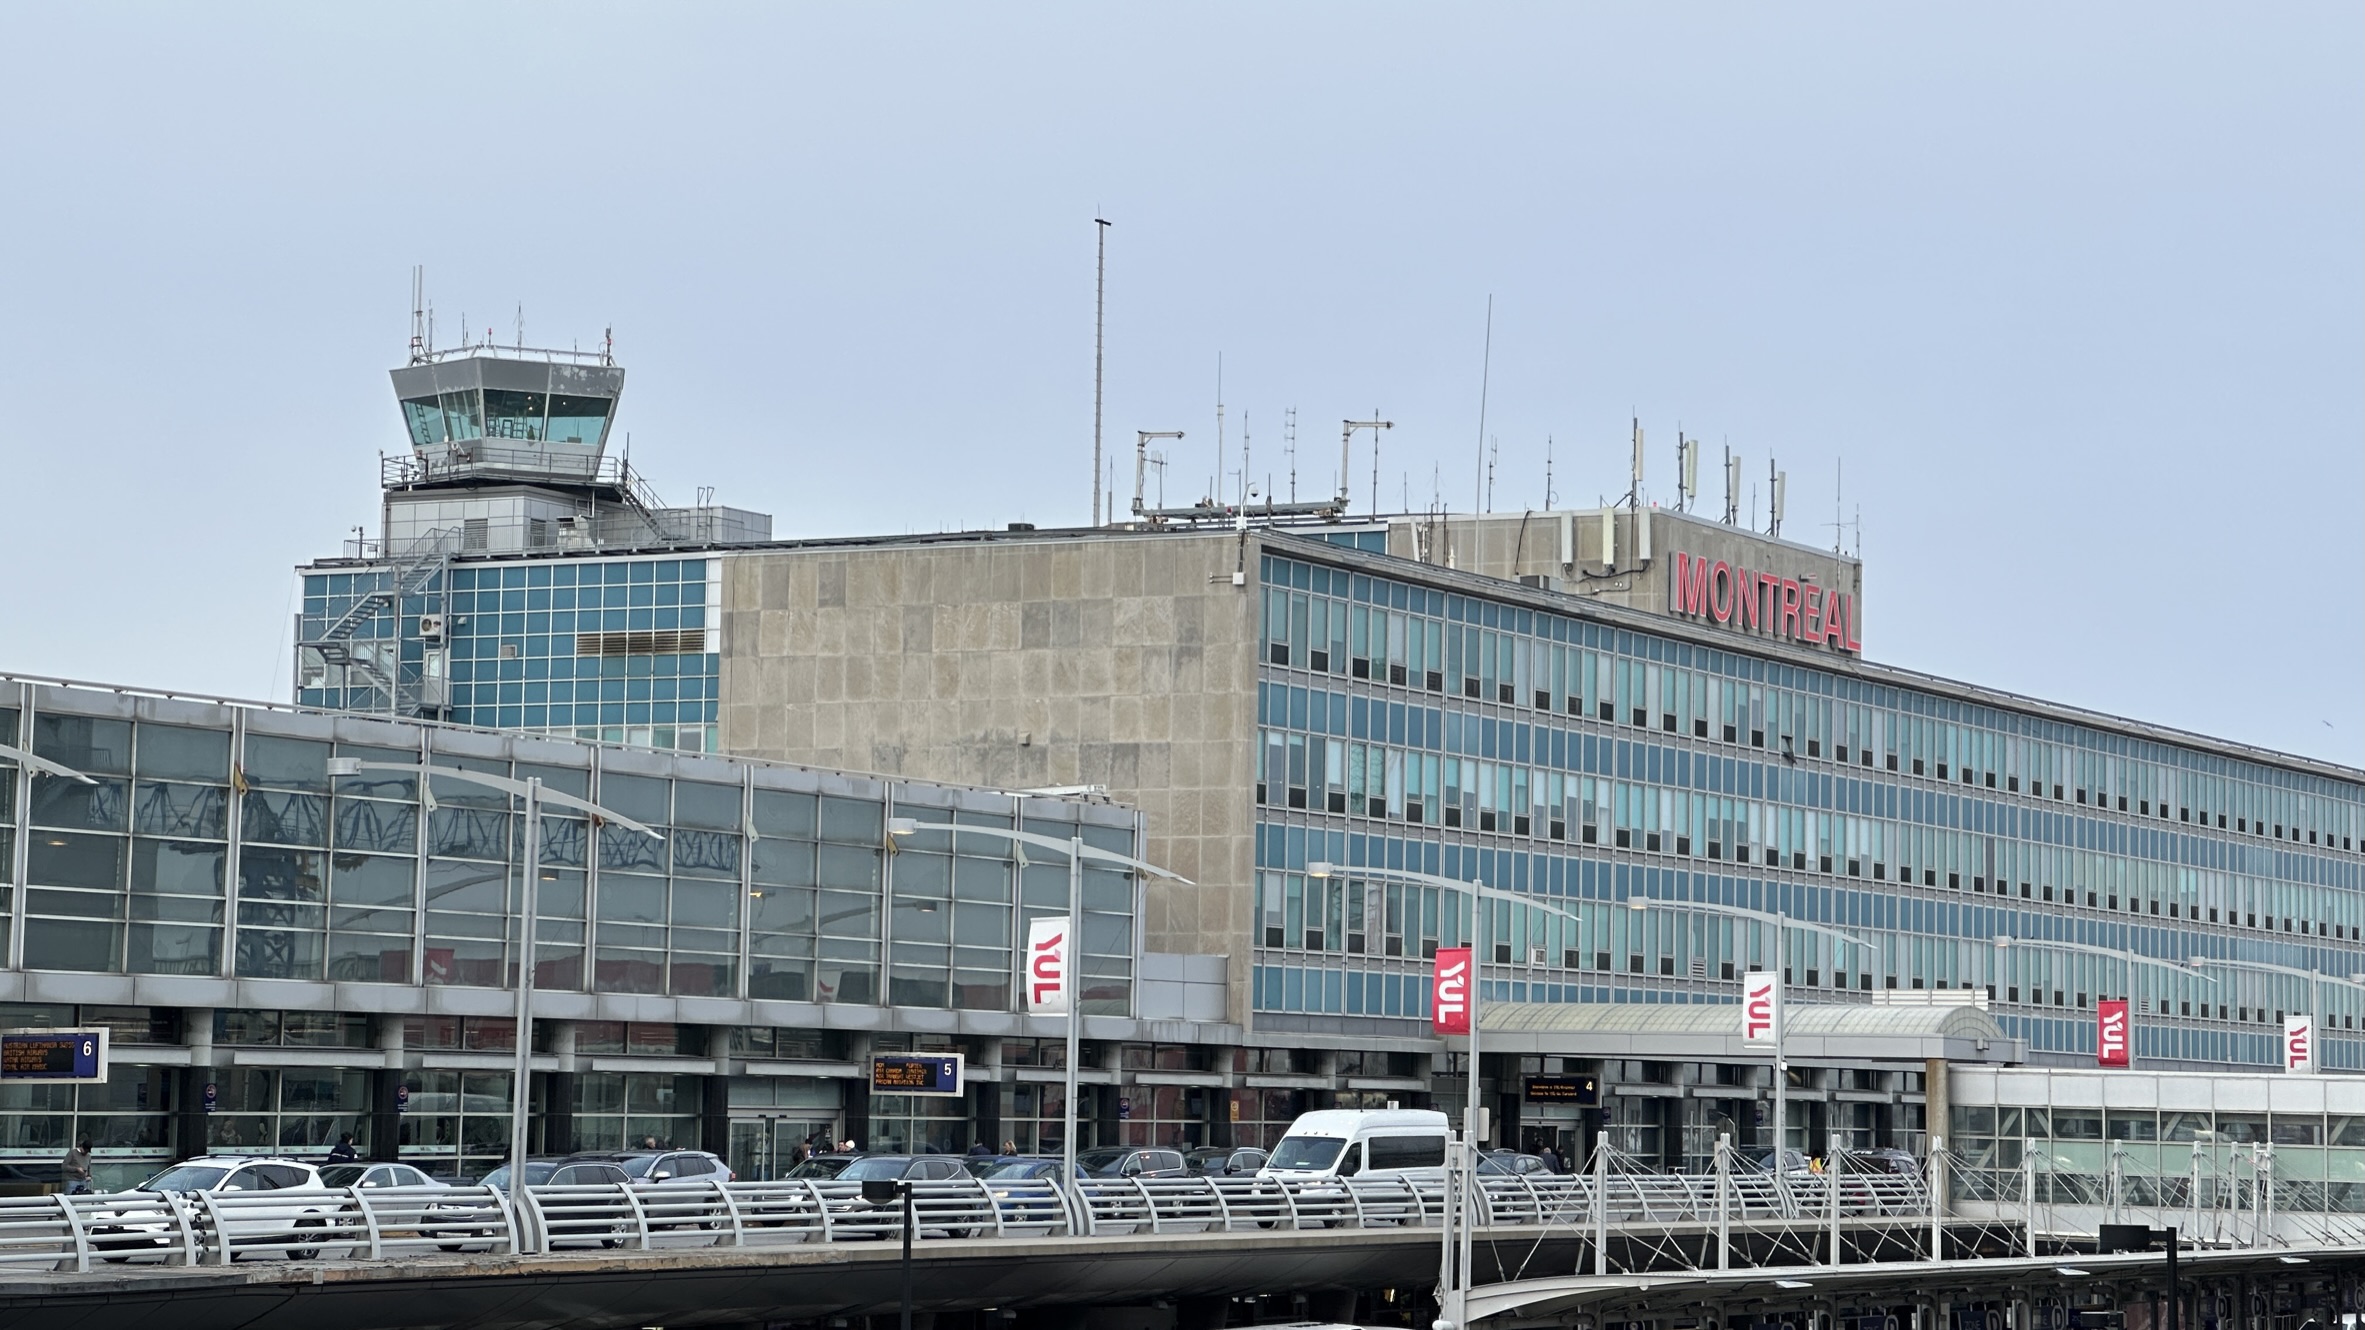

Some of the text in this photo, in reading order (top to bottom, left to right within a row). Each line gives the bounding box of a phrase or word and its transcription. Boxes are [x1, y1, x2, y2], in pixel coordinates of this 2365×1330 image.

[1677, 551, 1861, 651] MONTRÉAL
[1033, 932, 1063, 1005] YUL
[1438, 960, 1466, 1024] YUL
[1748, 983, 1772, 1039] YUL
[2103, 1010, 2124, 1059] YUL
[83, 1040, 92, 1056] 6
[944, 1063, 952, 1076] 5
[2289, 1025, 2308, 1069] YUL
[1585, 1081, 1593, 1091] 4
